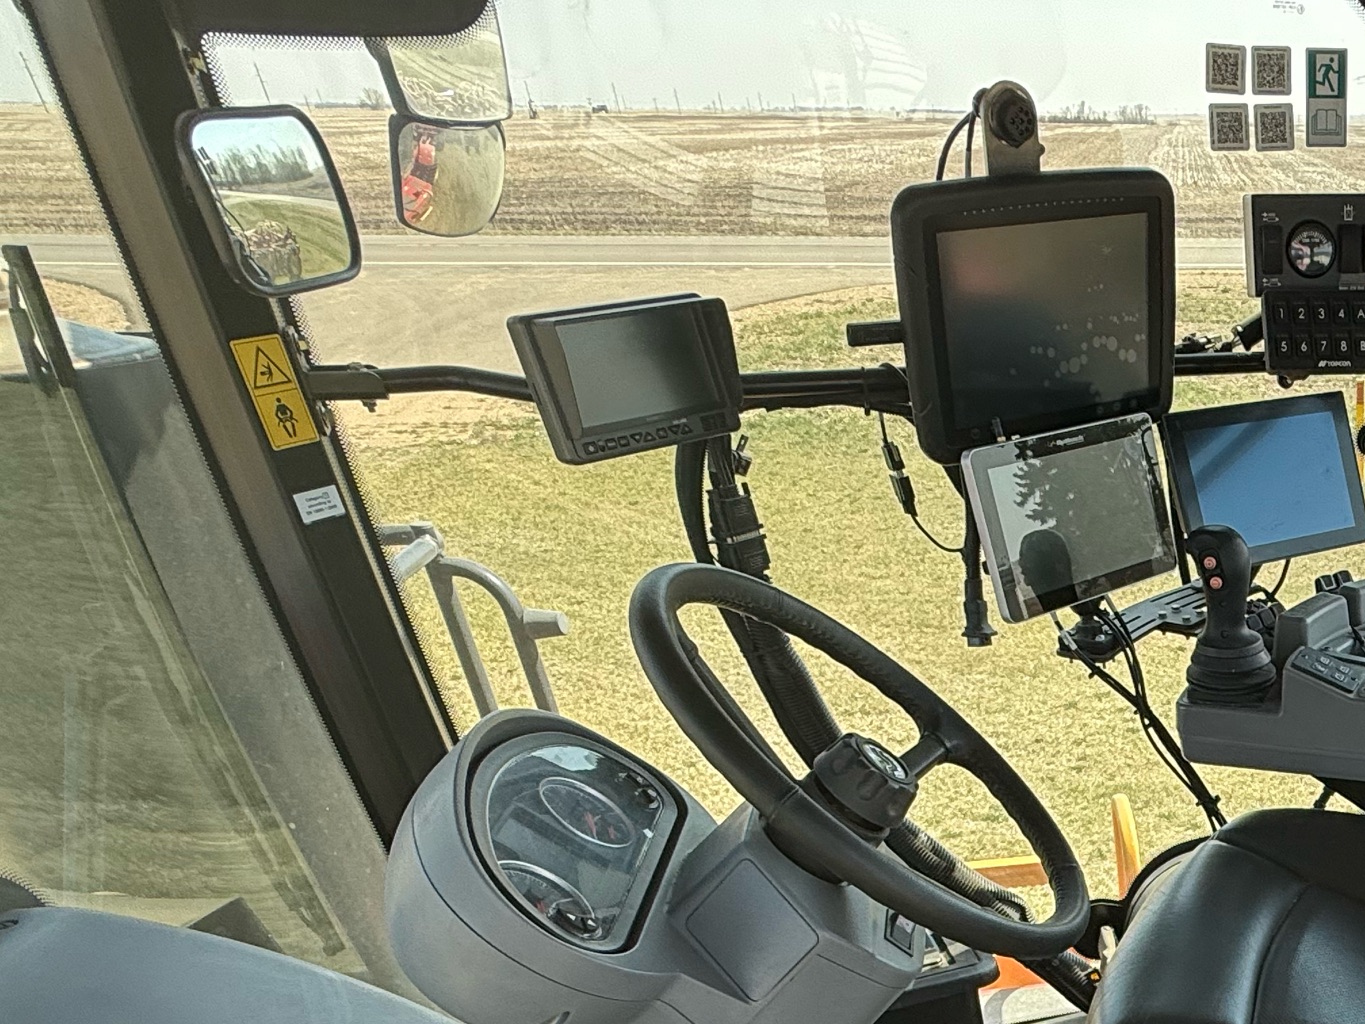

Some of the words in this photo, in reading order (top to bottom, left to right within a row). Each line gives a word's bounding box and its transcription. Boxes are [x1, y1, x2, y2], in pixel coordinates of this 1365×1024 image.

[1298, 308, 1305, 319] 2
[1318, 308, 1325, 319] 3
[1338, 308, 1345, 319] 4
[1357, 308, 1365, 319] A
[1280, 341, 1288, 352] 5
[1300, 341, 1308, 352] 6
[1320, 341, 1327, 352] 7
[1340, 341, 1348, 352] 8
